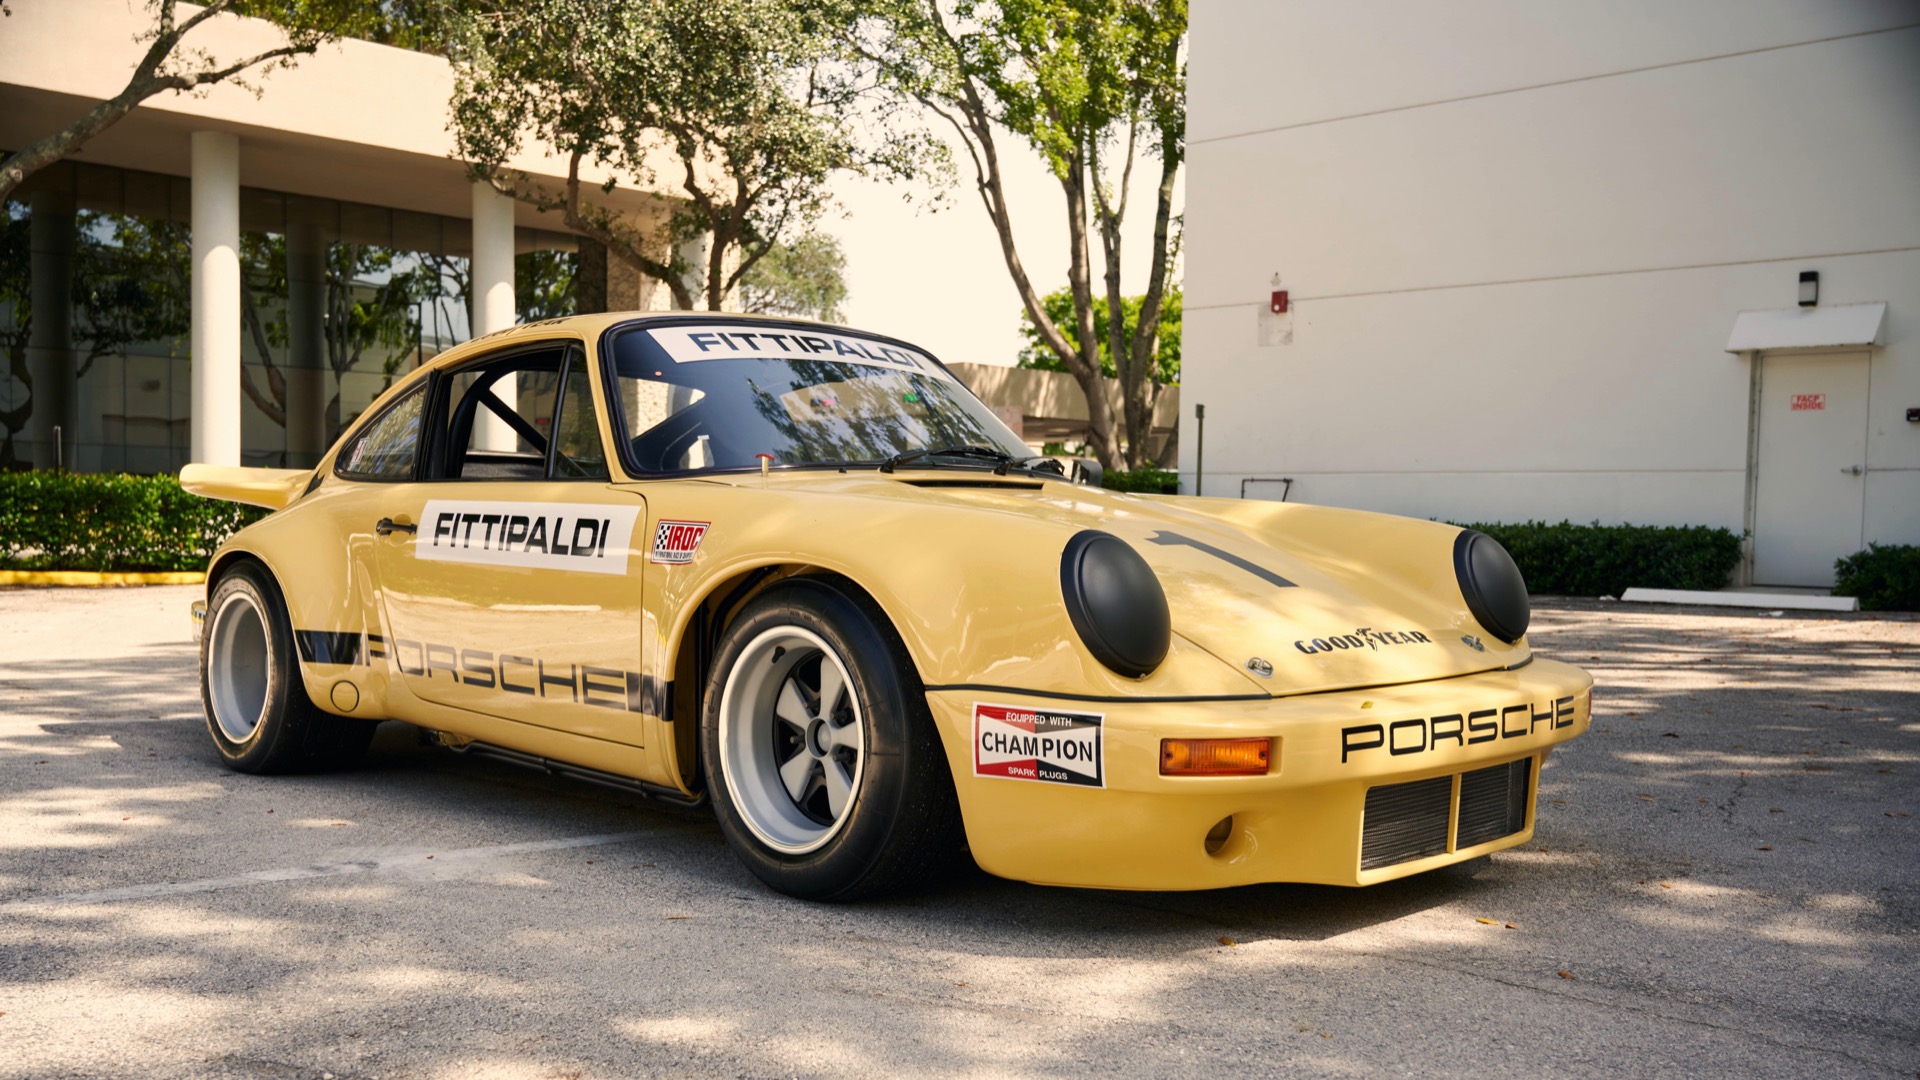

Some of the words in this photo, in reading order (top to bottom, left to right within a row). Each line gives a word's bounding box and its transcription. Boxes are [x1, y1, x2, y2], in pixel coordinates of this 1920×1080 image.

[688, 332, 924, 370] FITTIPALDI
[433, 513, 610, 558] FITTIPALDI
[666, 525, 704, 551] IROC
[364, 634, 626, 710] PORSCHE
[1005, 711, 1046, 725] EQUIPPED
[1050, 717, 1072, 727] WITH
[1341, 695, 1574, 764] PORSCHE
[981, 731, 1093, 762] CHAMPION
[1007, 766, 1036, 777] SPARK
[1039, 769, 1068, 780] PLUGS
